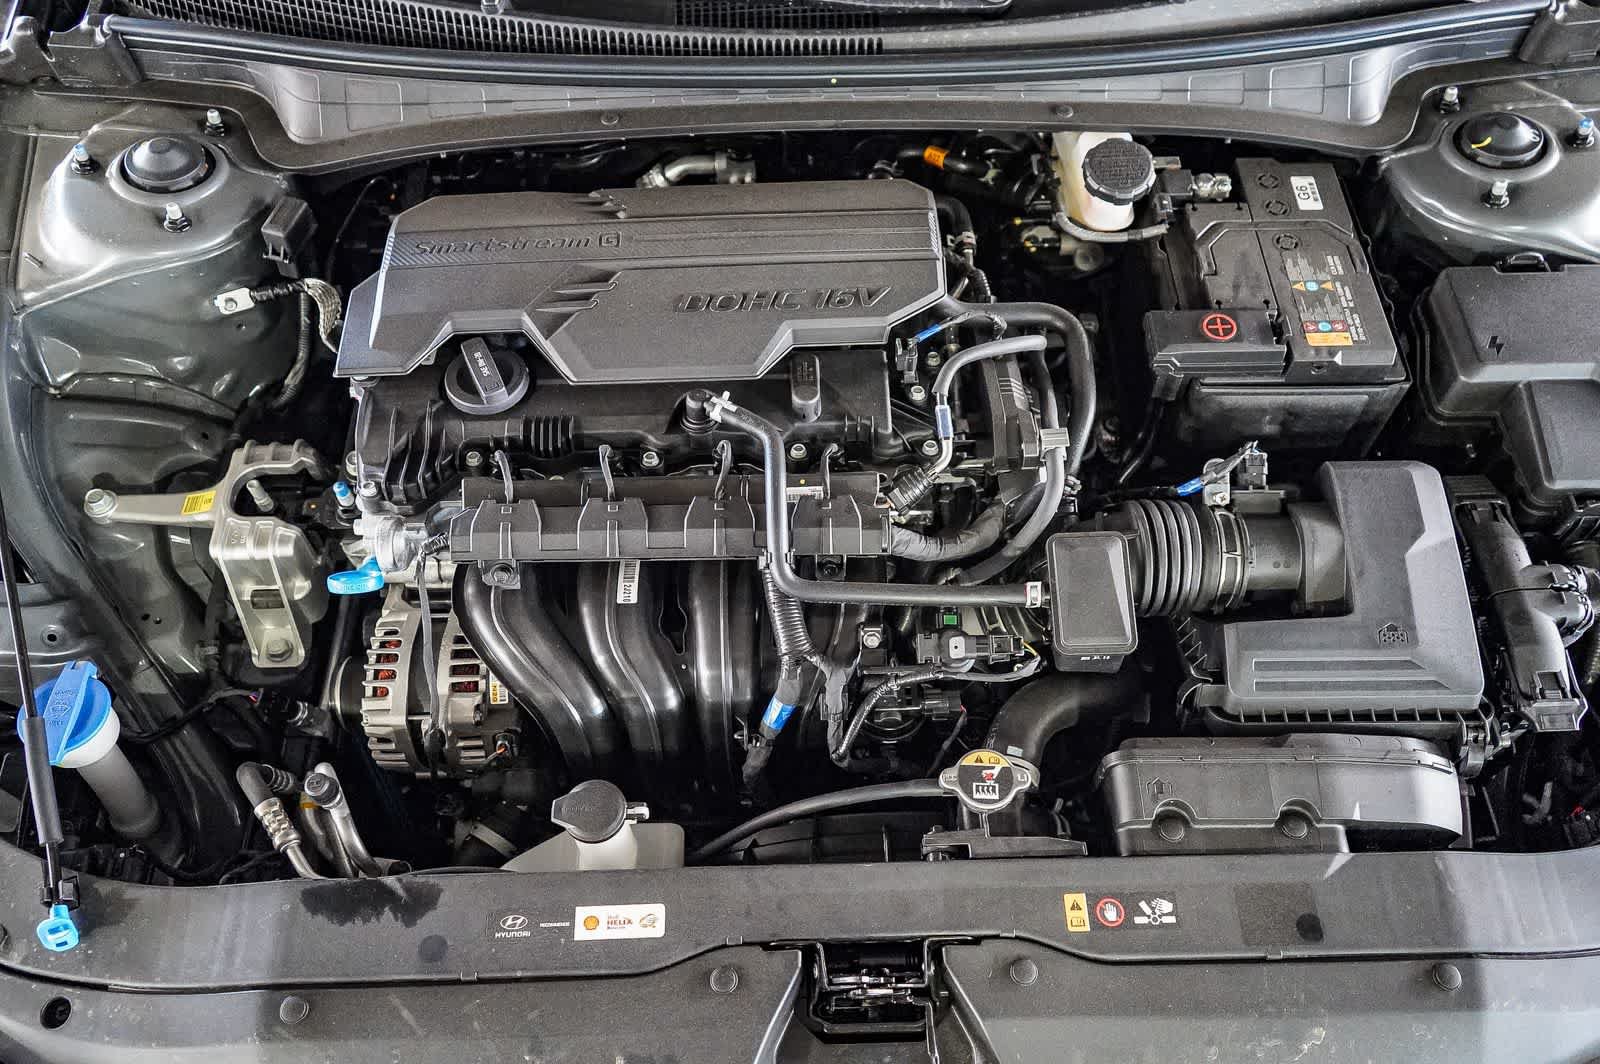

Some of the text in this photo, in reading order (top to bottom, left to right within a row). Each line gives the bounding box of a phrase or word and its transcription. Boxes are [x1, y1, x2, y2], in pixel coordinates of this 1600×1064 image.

[1295, 185, 1310, 200] G6
[414, 236, 592, 255] Smartstream
[676, 286, 892, 313] DOHC 16V
[494, 931, 531, 939] HYUNDAI
